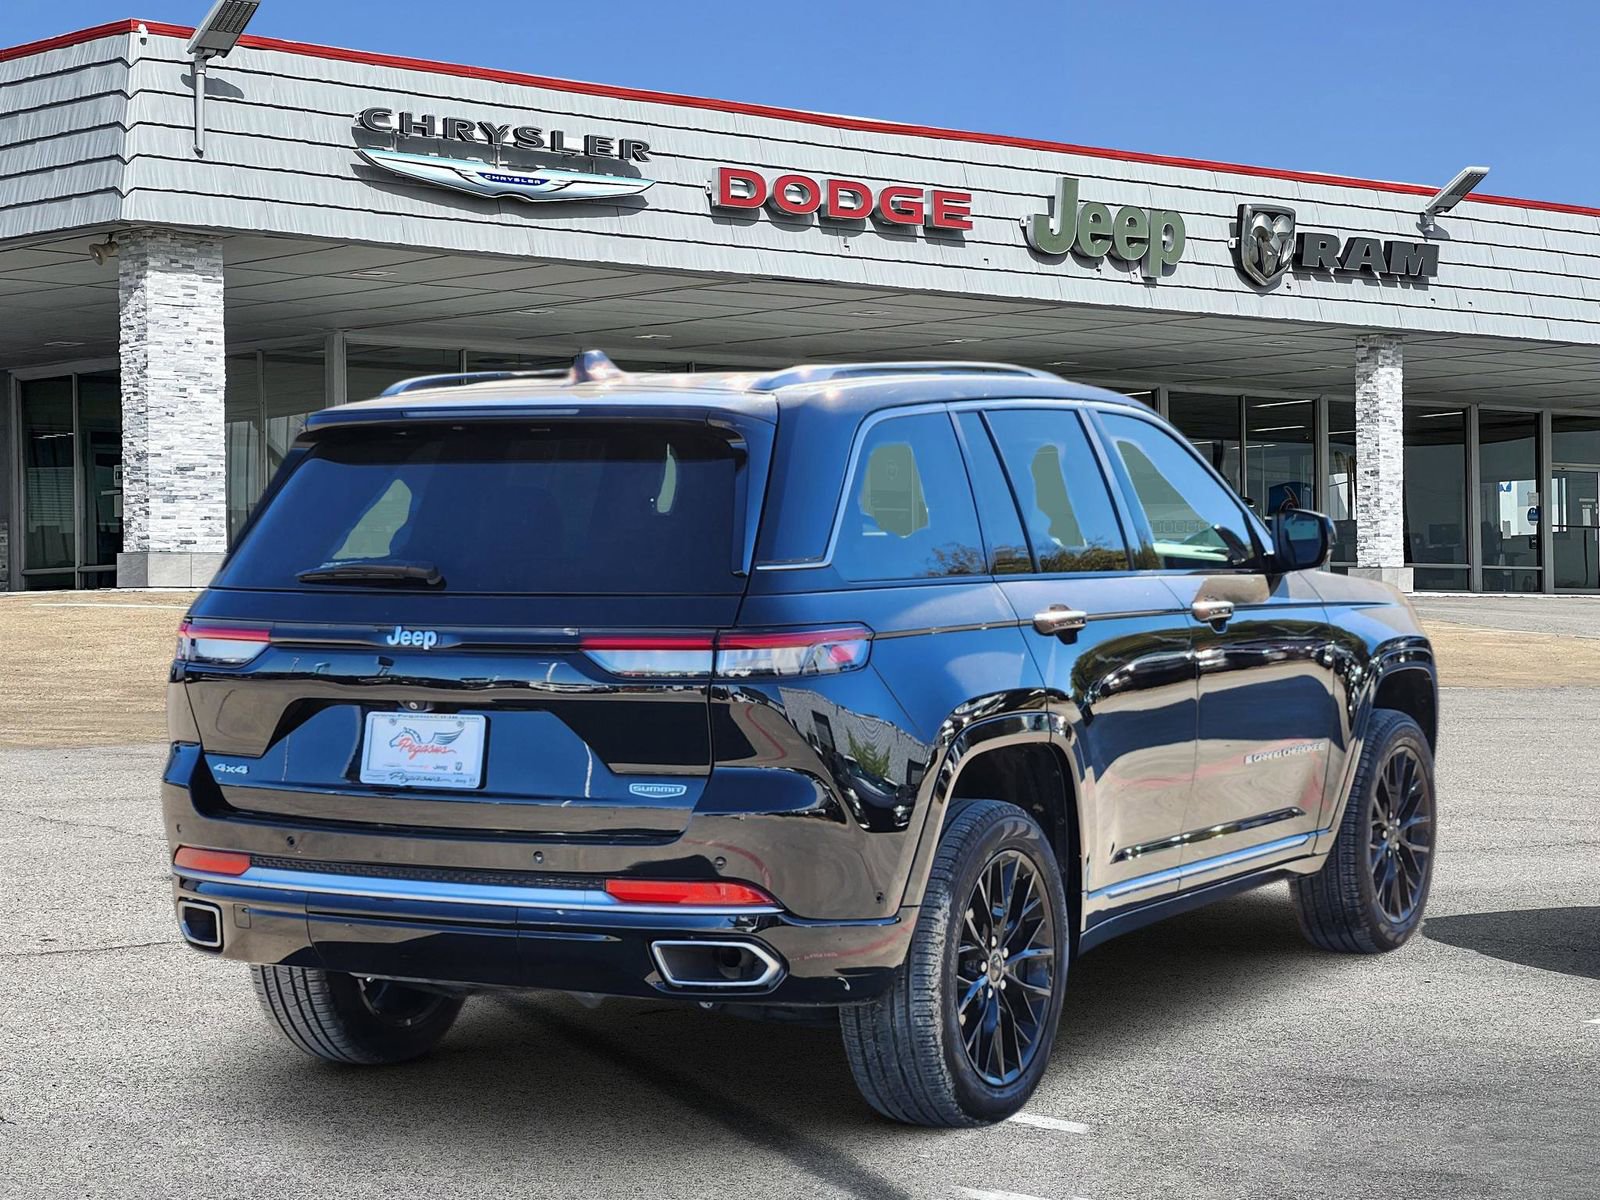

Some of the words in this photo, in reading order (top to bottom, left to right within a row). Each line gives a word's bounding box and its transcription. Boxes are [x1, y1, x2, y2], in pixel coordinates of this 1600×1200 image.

[357, 106, 650, 162] CHRYSLER
[484, 174, 541, 185] CHRYSLER
[711, 166, 974, 231] DODGE
[1027, 177, 1187, 278] Jeep
[1296, 232, 1440, 277] RAM
[386, 625, 438, 651] Jeep
[213, 763, 249, 775] 4x4
